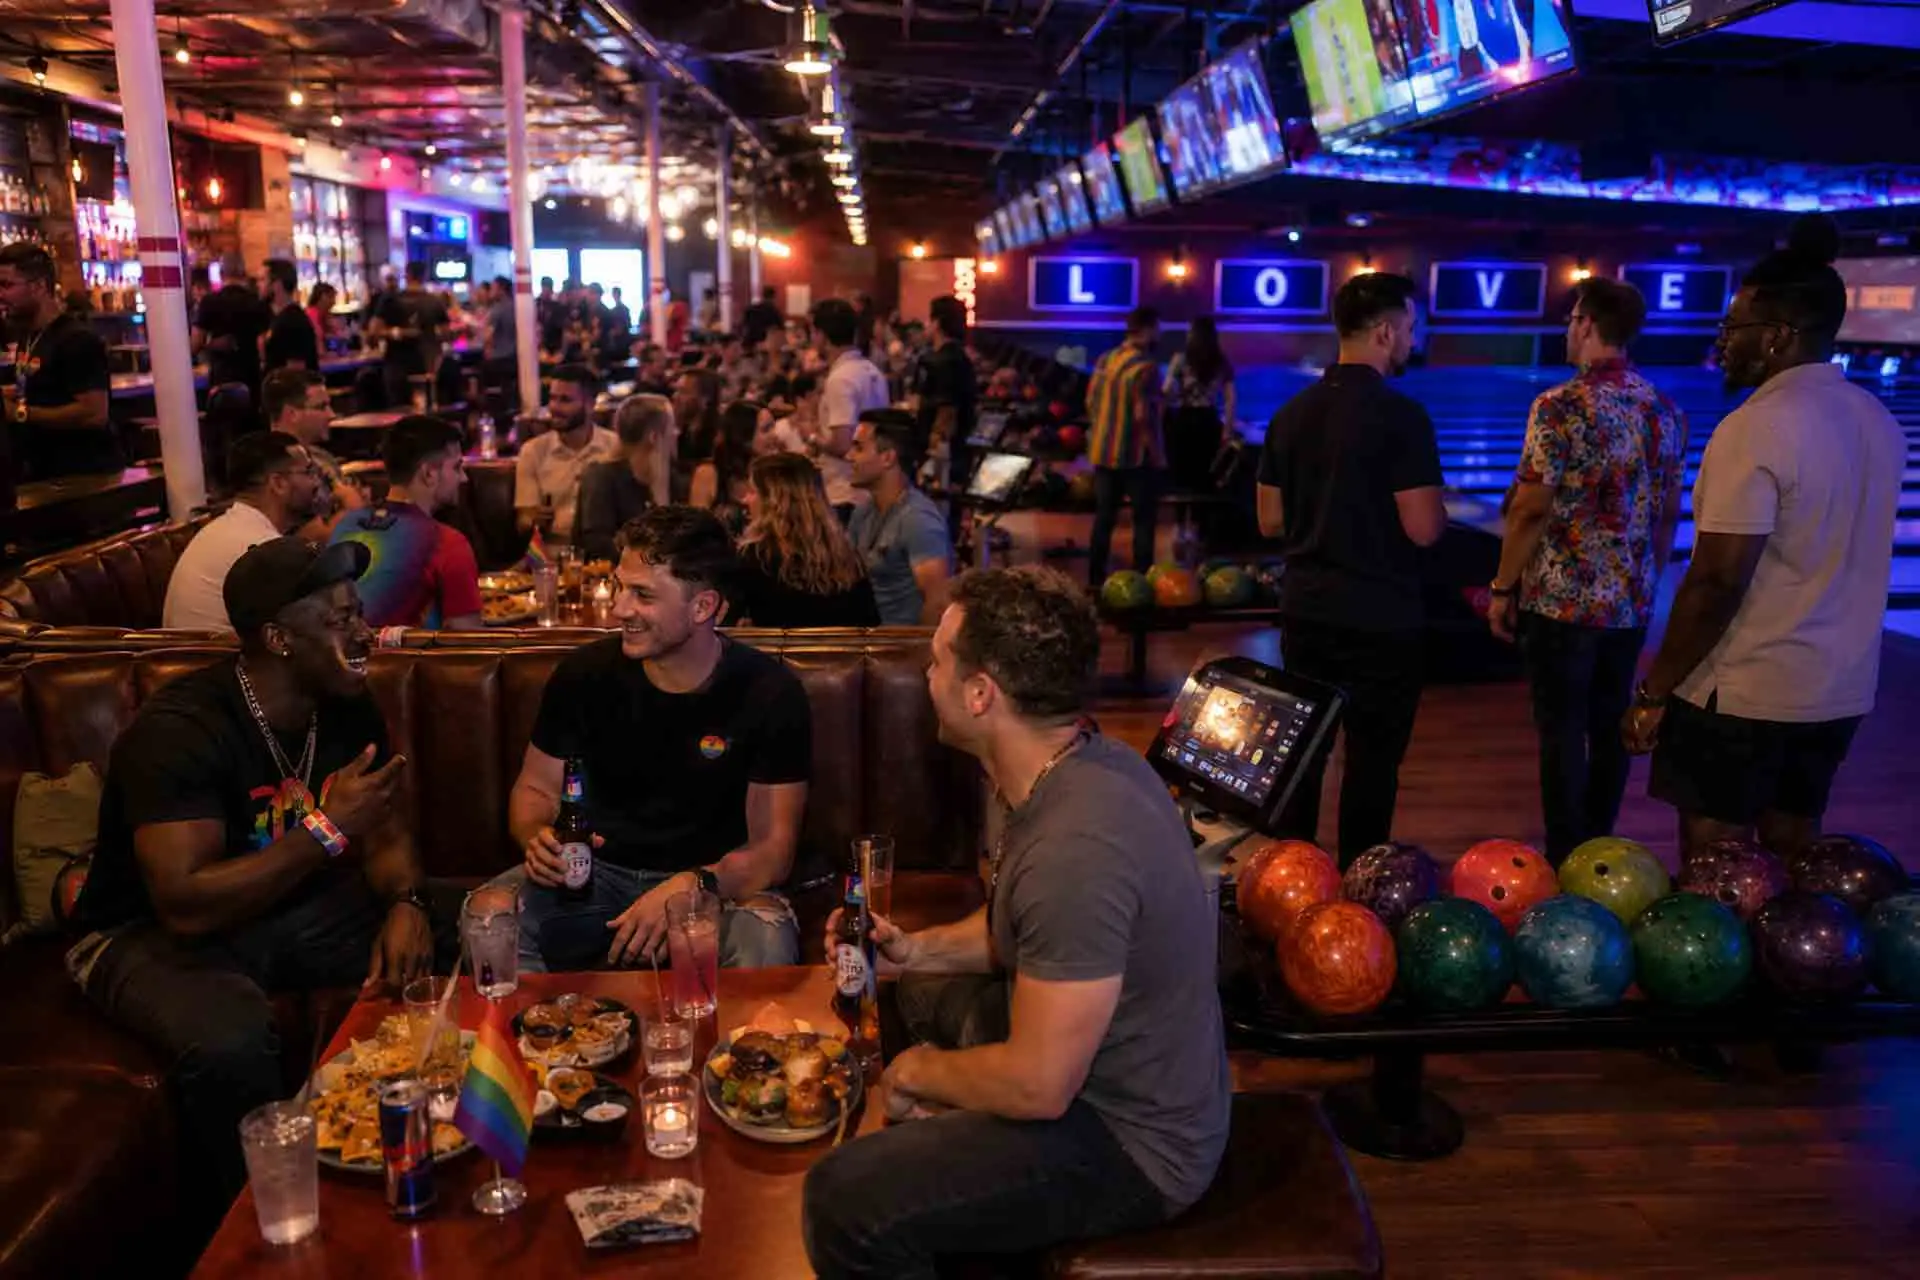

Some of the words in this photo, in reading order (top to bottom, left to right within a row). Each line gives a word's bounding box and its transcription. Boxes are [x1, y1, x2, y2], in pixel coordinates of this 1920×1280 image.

[1068, 265, 1095, 303] L
[1255, 268, 1287, 306] O
[1476, 272, 1504, 308] V
[1659, 273, 1685, 309] E
